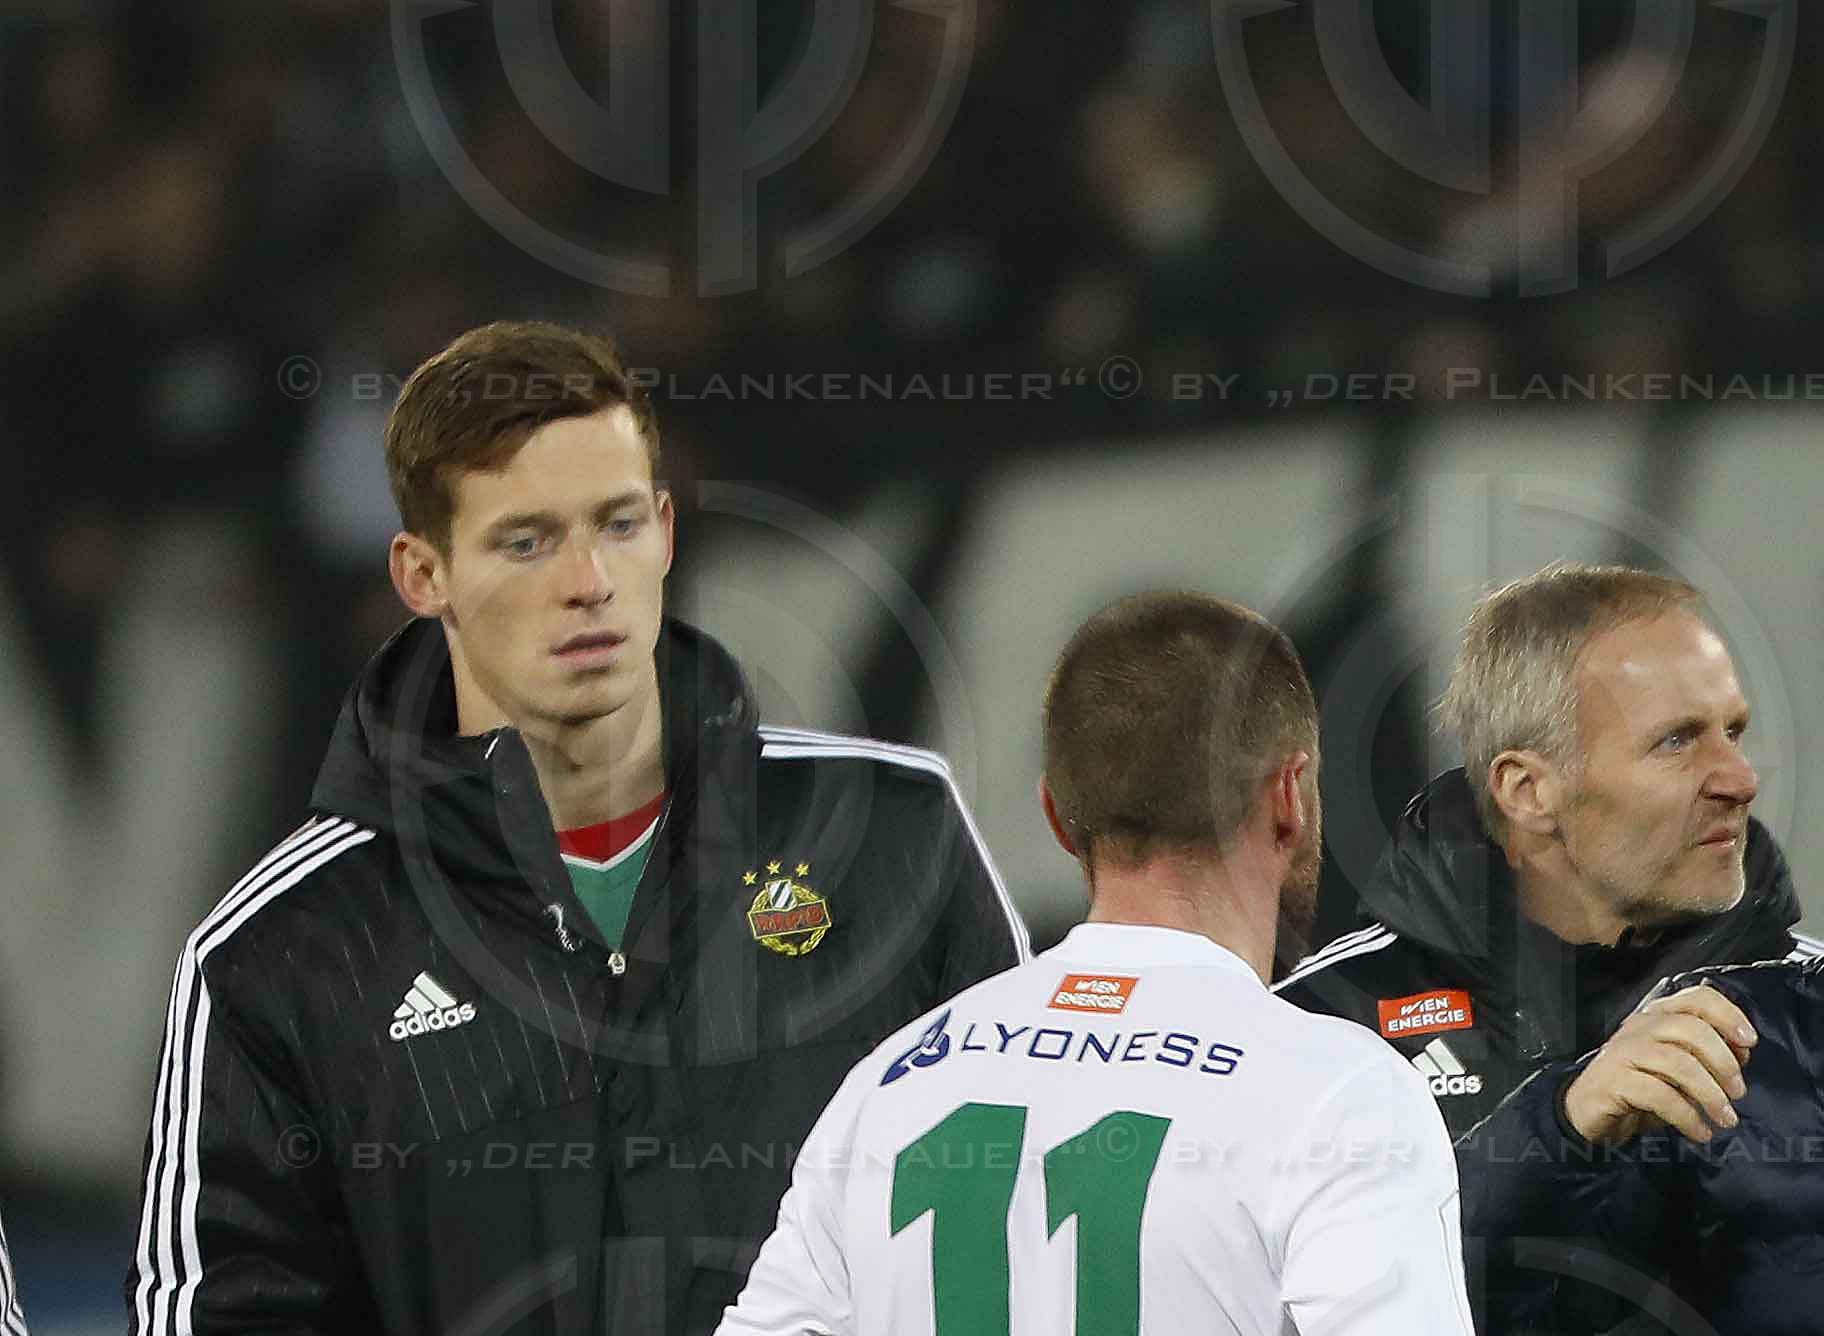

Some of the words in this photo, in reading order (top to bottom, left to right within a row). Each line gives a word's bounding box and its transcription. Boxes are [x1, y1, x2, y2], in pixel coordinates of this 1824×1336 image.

[1400, 996, 1450, 1016] WIEN
[388, 999, 478, 1041] adidas
[1387, 1009, 1466, 1032] ENERGIE
[960, 1022, 1245, 1076] LYONESS
[1430, 1074, 1484, 1097] das
